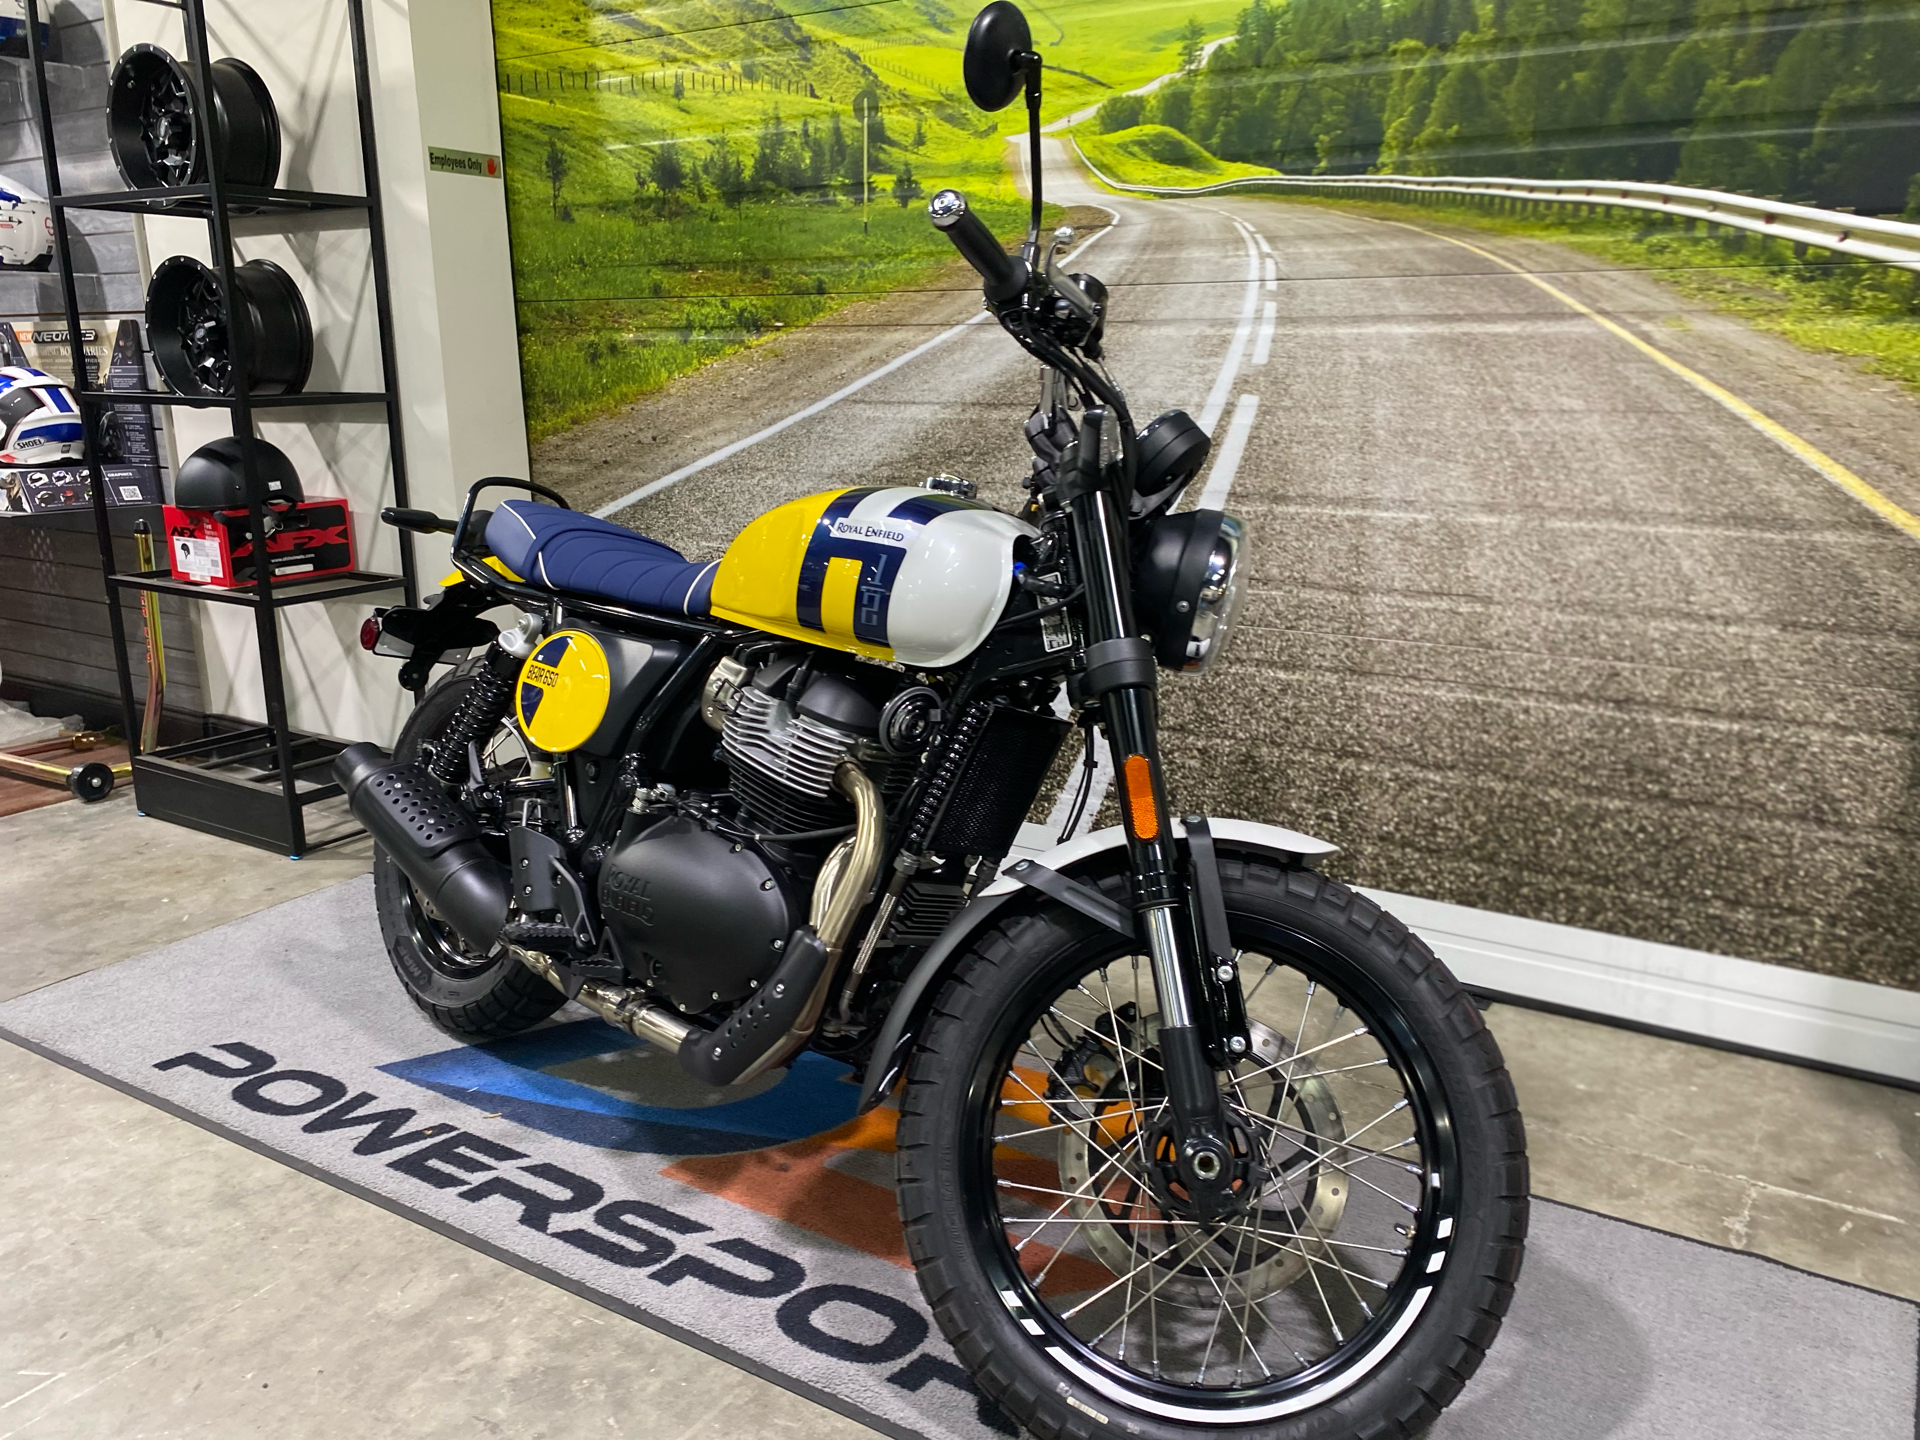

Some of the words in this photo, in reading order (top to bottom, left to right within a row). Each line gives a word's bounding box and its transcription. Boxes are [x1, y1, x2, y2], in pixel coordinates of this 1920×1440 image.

[430, 152, 466, 171] Employees
[467, 157, 483, 174] Only
[17, 438, 43, 449] SHOEI
[170, 526, 198, 538] AFX
[526, 664, 546, 683] BEAR
[542, 669, 560, 688] 650
[605, 863, 651, 901] ROYAL
